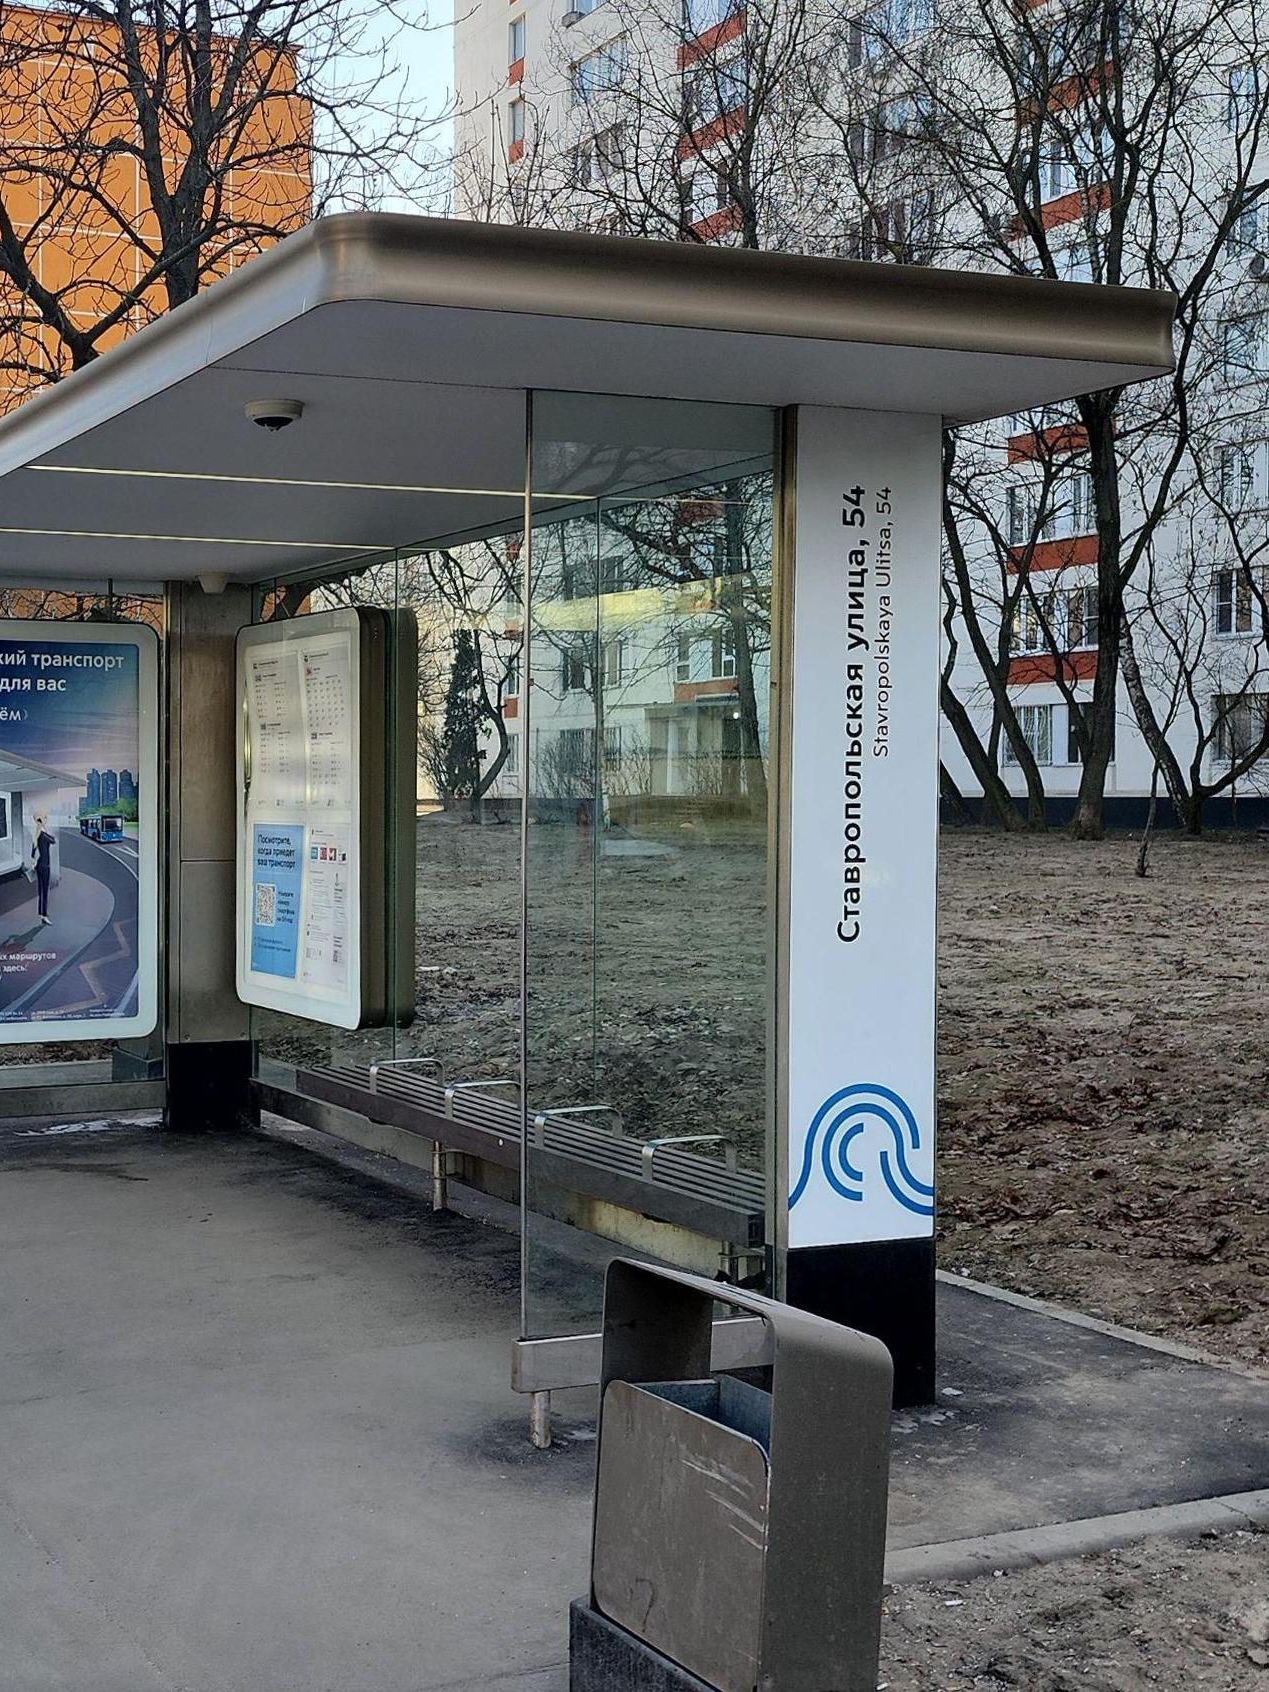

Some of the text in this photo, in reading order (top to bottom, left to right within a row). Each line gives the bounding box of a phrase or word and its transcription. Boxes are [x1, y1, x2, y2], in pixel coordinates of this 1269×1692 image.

[873, 486, 894, 758] Stavropolskaya Ulitsa, 54
[31, 653, 124, 672] транспорт
[37, 677, 67, 692] вас
[837, 484, 870, 943] Ставропольская улица, 54
[10, 952, 57, 962] маршрутов
